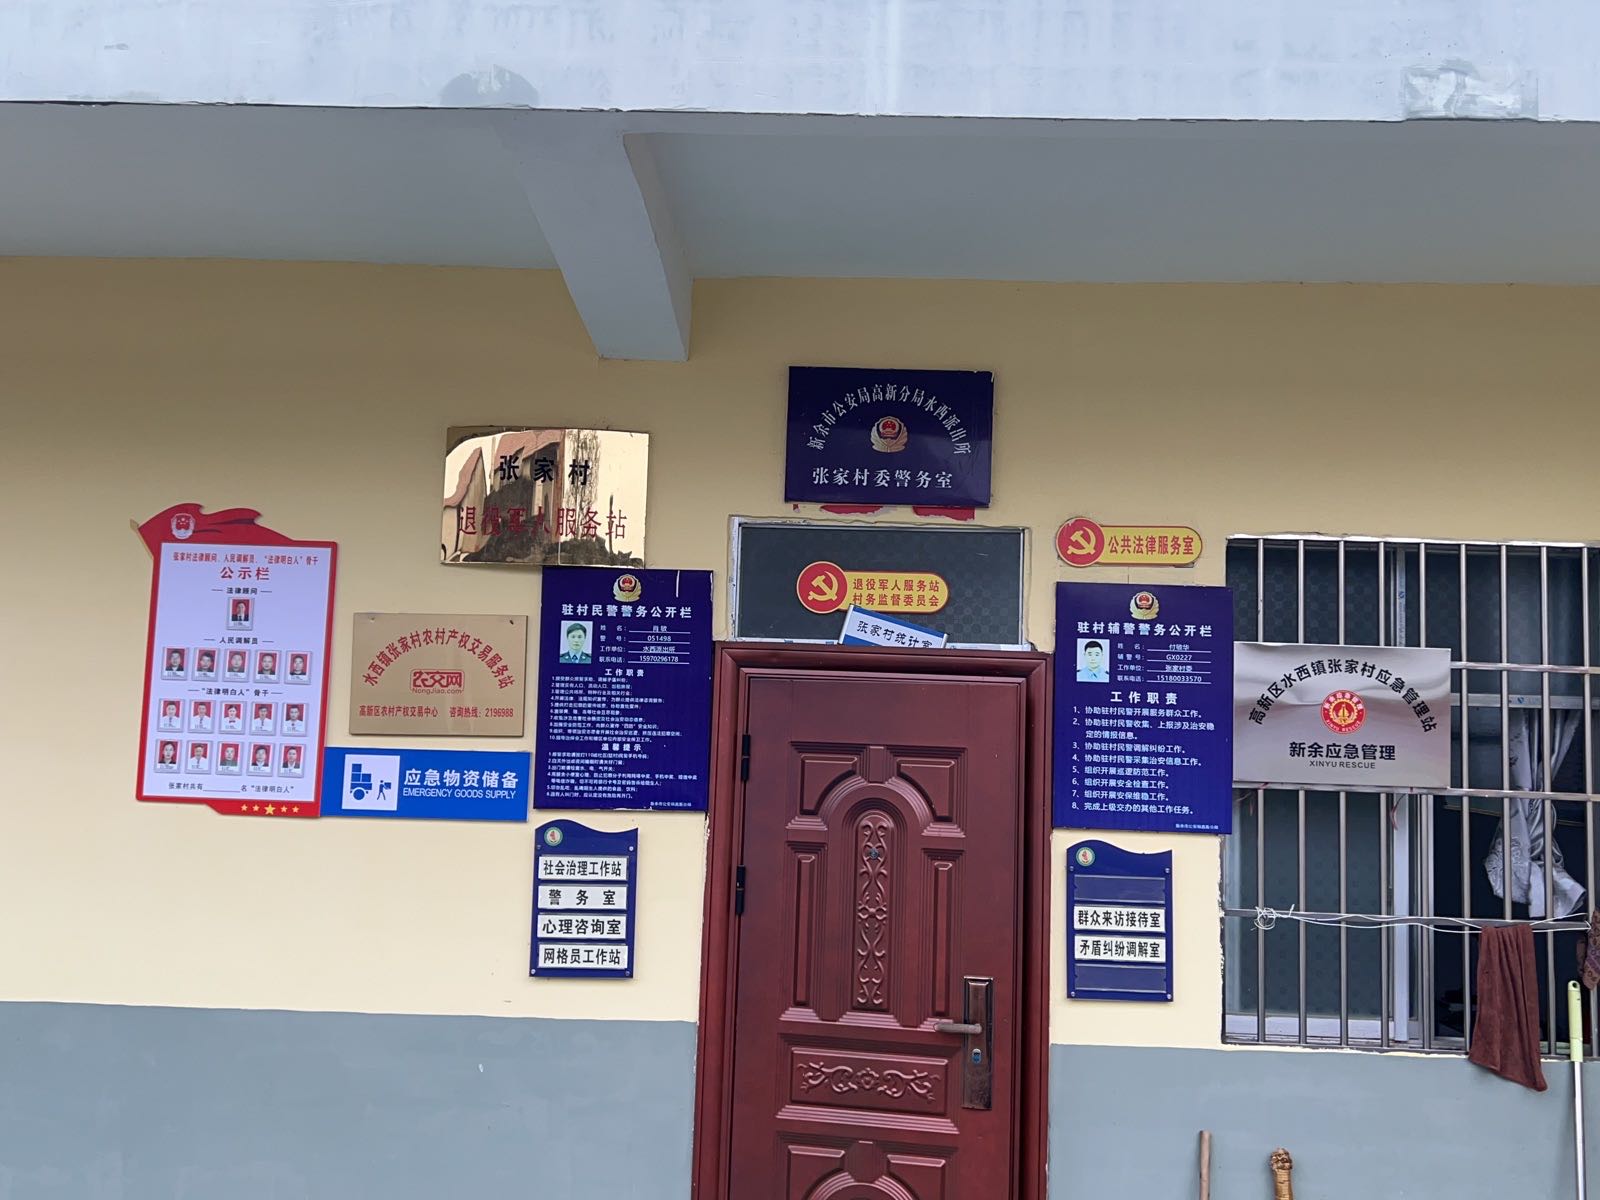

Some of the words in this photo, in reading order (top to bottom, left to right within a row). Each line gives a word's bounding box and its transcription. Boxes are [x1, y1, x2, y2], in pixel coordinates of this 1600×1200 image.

[807, 384, 971, 454] 新余市公安局高新分局水西派出所
[499, 455, 590, 485] 张家村
[812, 467, 952, 489] 张家村委警务室
[459, 506, 627, 539] 退役军人服务站
[1108, 535, 1194, 555] 公共法律服务室
[220, 567, 270, 580] 公示栏
[226, 587, 258, 595] 法律顾问
[853, 578, 940, 593] 退役军人服务站
[853, 593, 940, 606] 村务监督委员会
[562, 604, 692, 618] 驻村民警警务公开栏
[1077, 621, 1212, 637] 驻村辅警警务公开栏
[219, 637, 258, 645] 人民调解员
[364, 628, 515, 689] 水西镇张家村农村产权交易服务站
[1166, 653, 1193, 661] GX0227
[605, 669, 645, 677] 工作职责
[1110, 691, 1178, 705] 工作职责
[1249, 658, 1437, 733] 高新区水西镇张家村应急管理站
[359, 705, 438, 717] 高新区农村产权交易中心
[601, 743, 642, 751] 温馨提示
[1289, 741, 1396, 761] 新余应急管理
[1309, 760, 1338, 768] XINYU
[1339, 760, 1376, 769] RESCUE
[168, 782, 203, 790] 张家村共有
[404, 768, 518, 789] 应急物资储备
[403, 788, 452, 798] EMERGENCY
[454, 789, 483, 798] GOODS
[485, 790, 516, 799] SUPPLY
[543, 860, 622, 877] 社会治理工作站
[549, 889, 616, 906] 警务室
[542, 919, 621, 935] 心理咨询室
[1078, 910, 1161, 928] 群众来访接待室
[543, 948, 621, 965] 网格员工作站
[1079, 940, 1160, 958] 矛盾纠纷调解室
